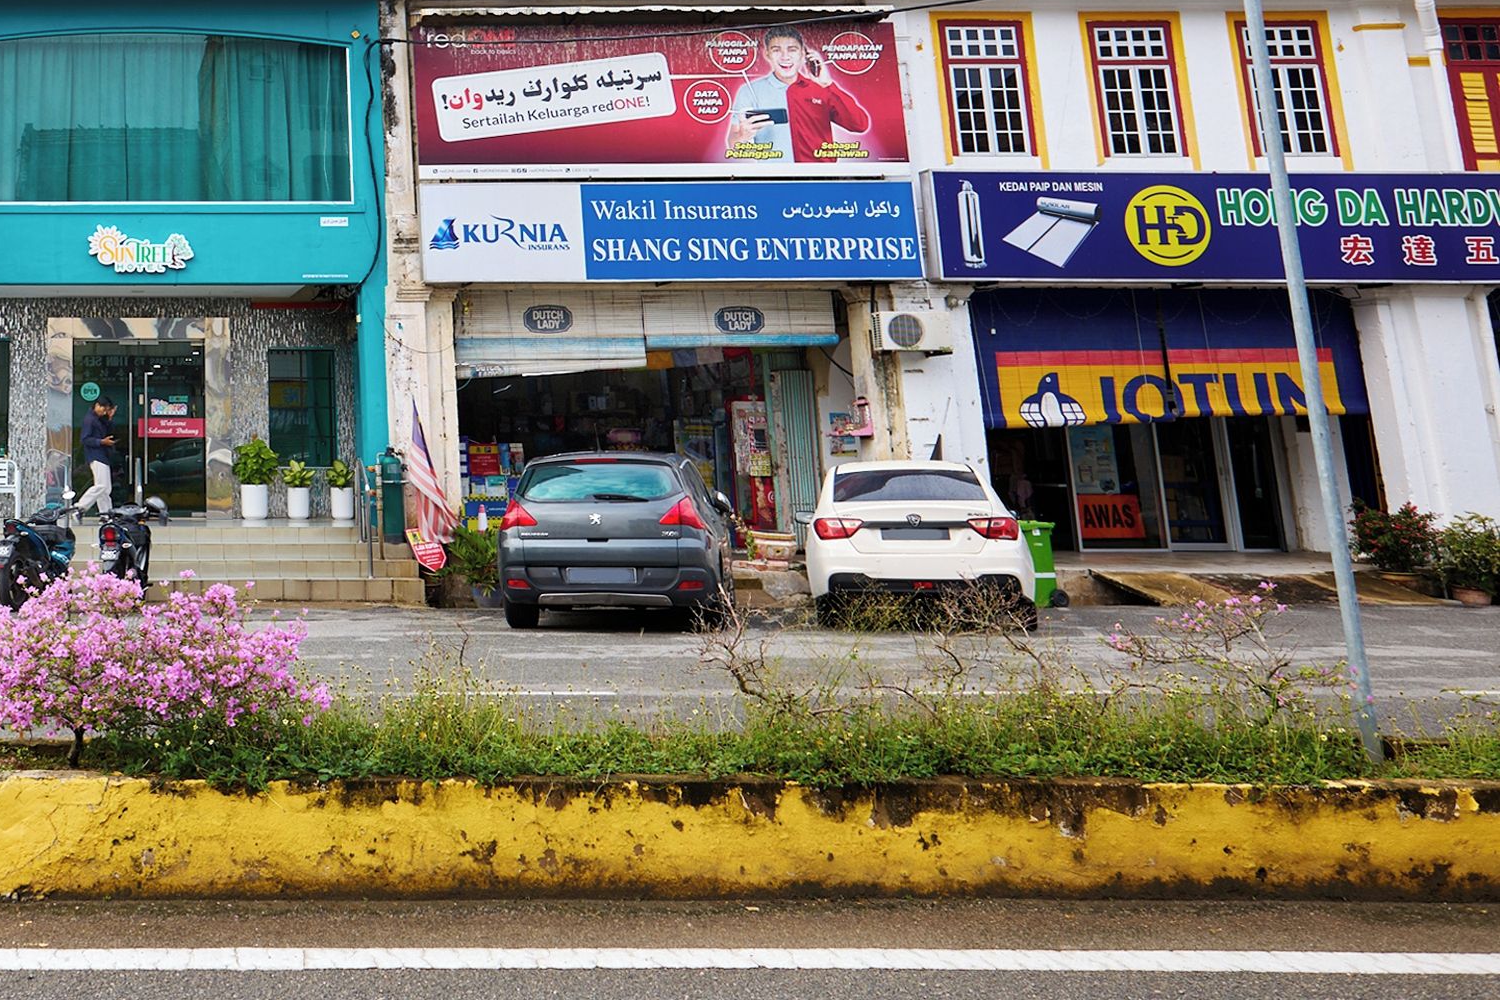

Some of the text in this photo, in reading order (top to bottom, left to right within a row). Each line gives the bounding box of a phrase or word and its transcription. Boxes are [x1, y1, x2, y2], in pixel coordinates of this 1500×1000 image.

[706, 40, 758, 48] PANGGILAN
[822, 44, 883, 52] PENDAPATAN
[827, 52, 880, 60] TANPA HAD
[462, 96, 651, 129] Sertailah Keluarga redONE!
[734, 142, 773, 151] Sebagai
[821, 141, 859, 151] Sebagai
[725, 150, 782, 160] Pelanggan
[813, 149, 868, 158] Usahawan
[999, 182, 1104, 192] KEDAI PAIP DAN MESIN
[590, 199, 758, 221] Wakil Insurans
[1335, 187, 1390, 227] DA
[1393, 187, 1500, 227] HARD
[463, 214, 569, 250] KURNIA
[593, 236, 917, 262] SHANG SING ENTERPRISE
[1340, 233, 1500, 266] 宏達五
[532, 311, 564, 320] DUTCH
[723, 311, 756, 321] DUTCH
[537, 320, 560, 329] LADY
[728, 321, 752, 330] LADY
[1084, 504, 1136, 529] AWAS
